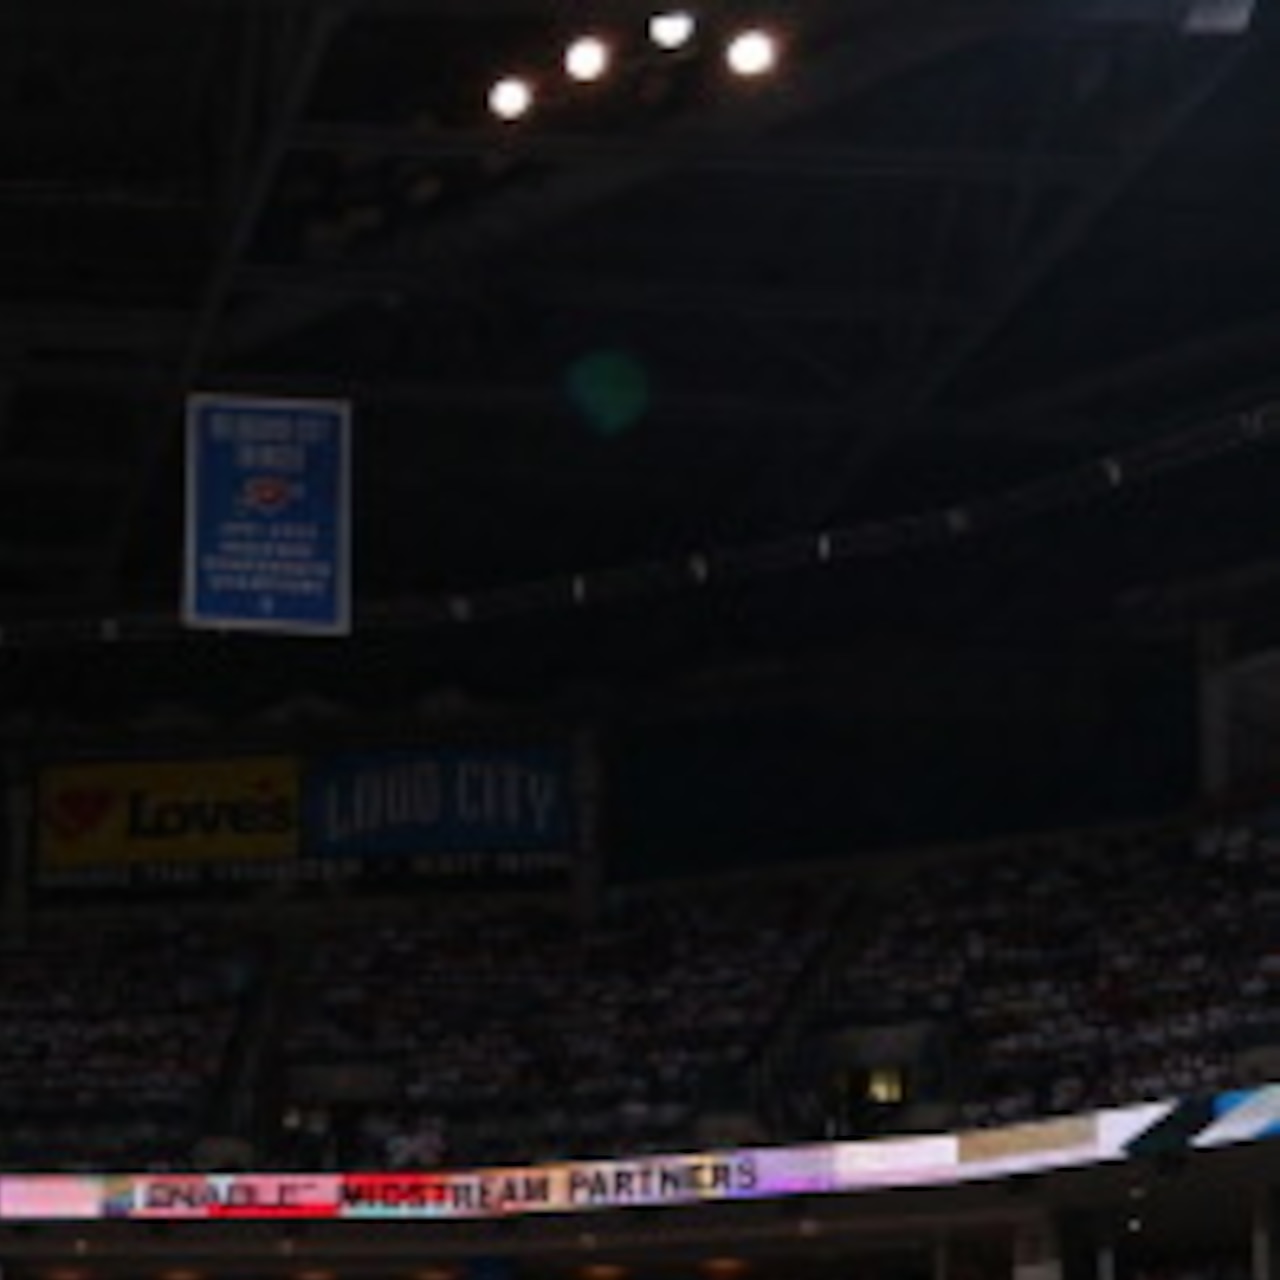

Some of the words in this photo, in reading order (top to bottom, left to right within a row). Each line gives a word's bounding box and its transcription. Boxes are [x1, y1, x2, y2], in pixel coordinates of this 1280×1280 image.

[325, 761, 442, 840] LOUD
[456, 761, 556, 832] CITY
[341, 1174, 549, 1210] MIDSTREAM
[569, 1156, 758, 1200] PARTNERS
